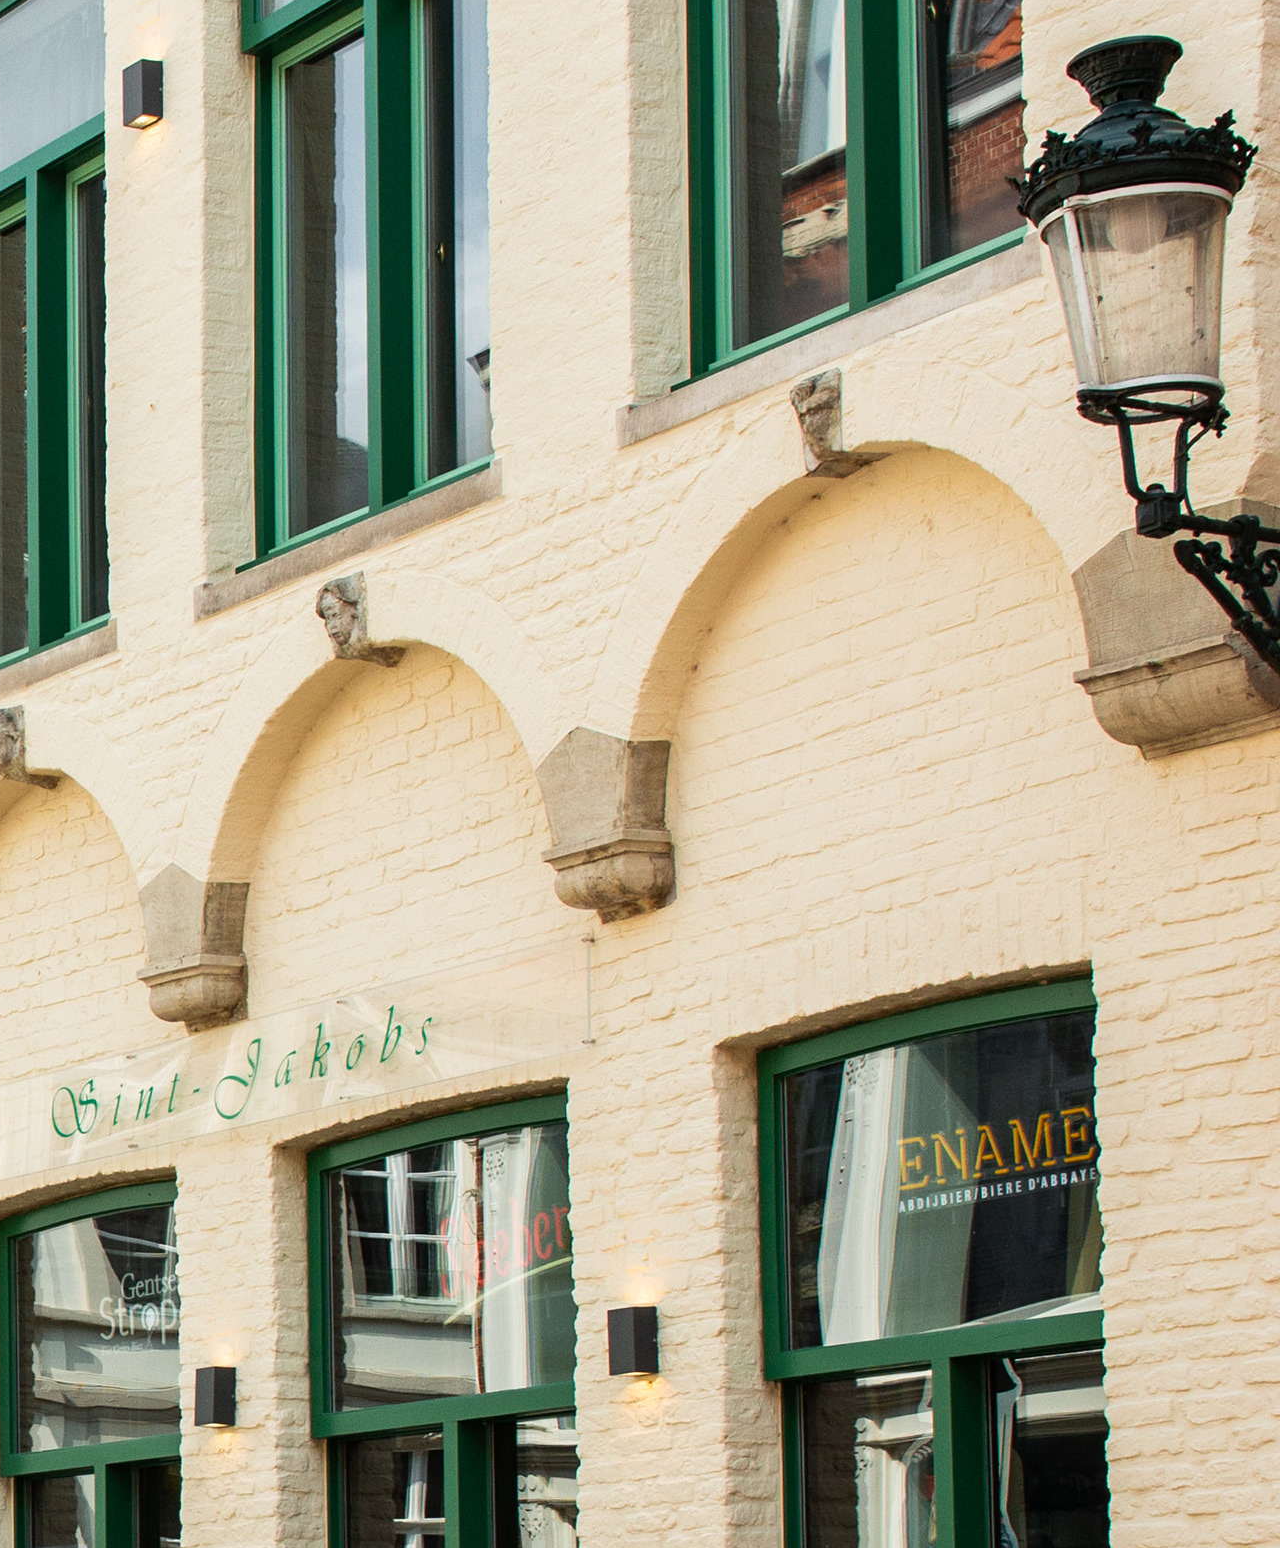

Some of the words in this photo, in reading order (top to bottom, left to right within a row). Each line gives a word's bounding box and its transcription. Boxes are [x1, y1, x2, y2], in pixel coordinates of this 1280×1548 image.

[51, 1004, 433, 1138] Sint-Jakobs
[898, 1106, 1096, 1190] ENAME
[1028, 1167, 1097, 1191] D'ABBAYE
[121, 1272, 177, 1300] Gentse
[100, 1296, 178, 1344] Strop
